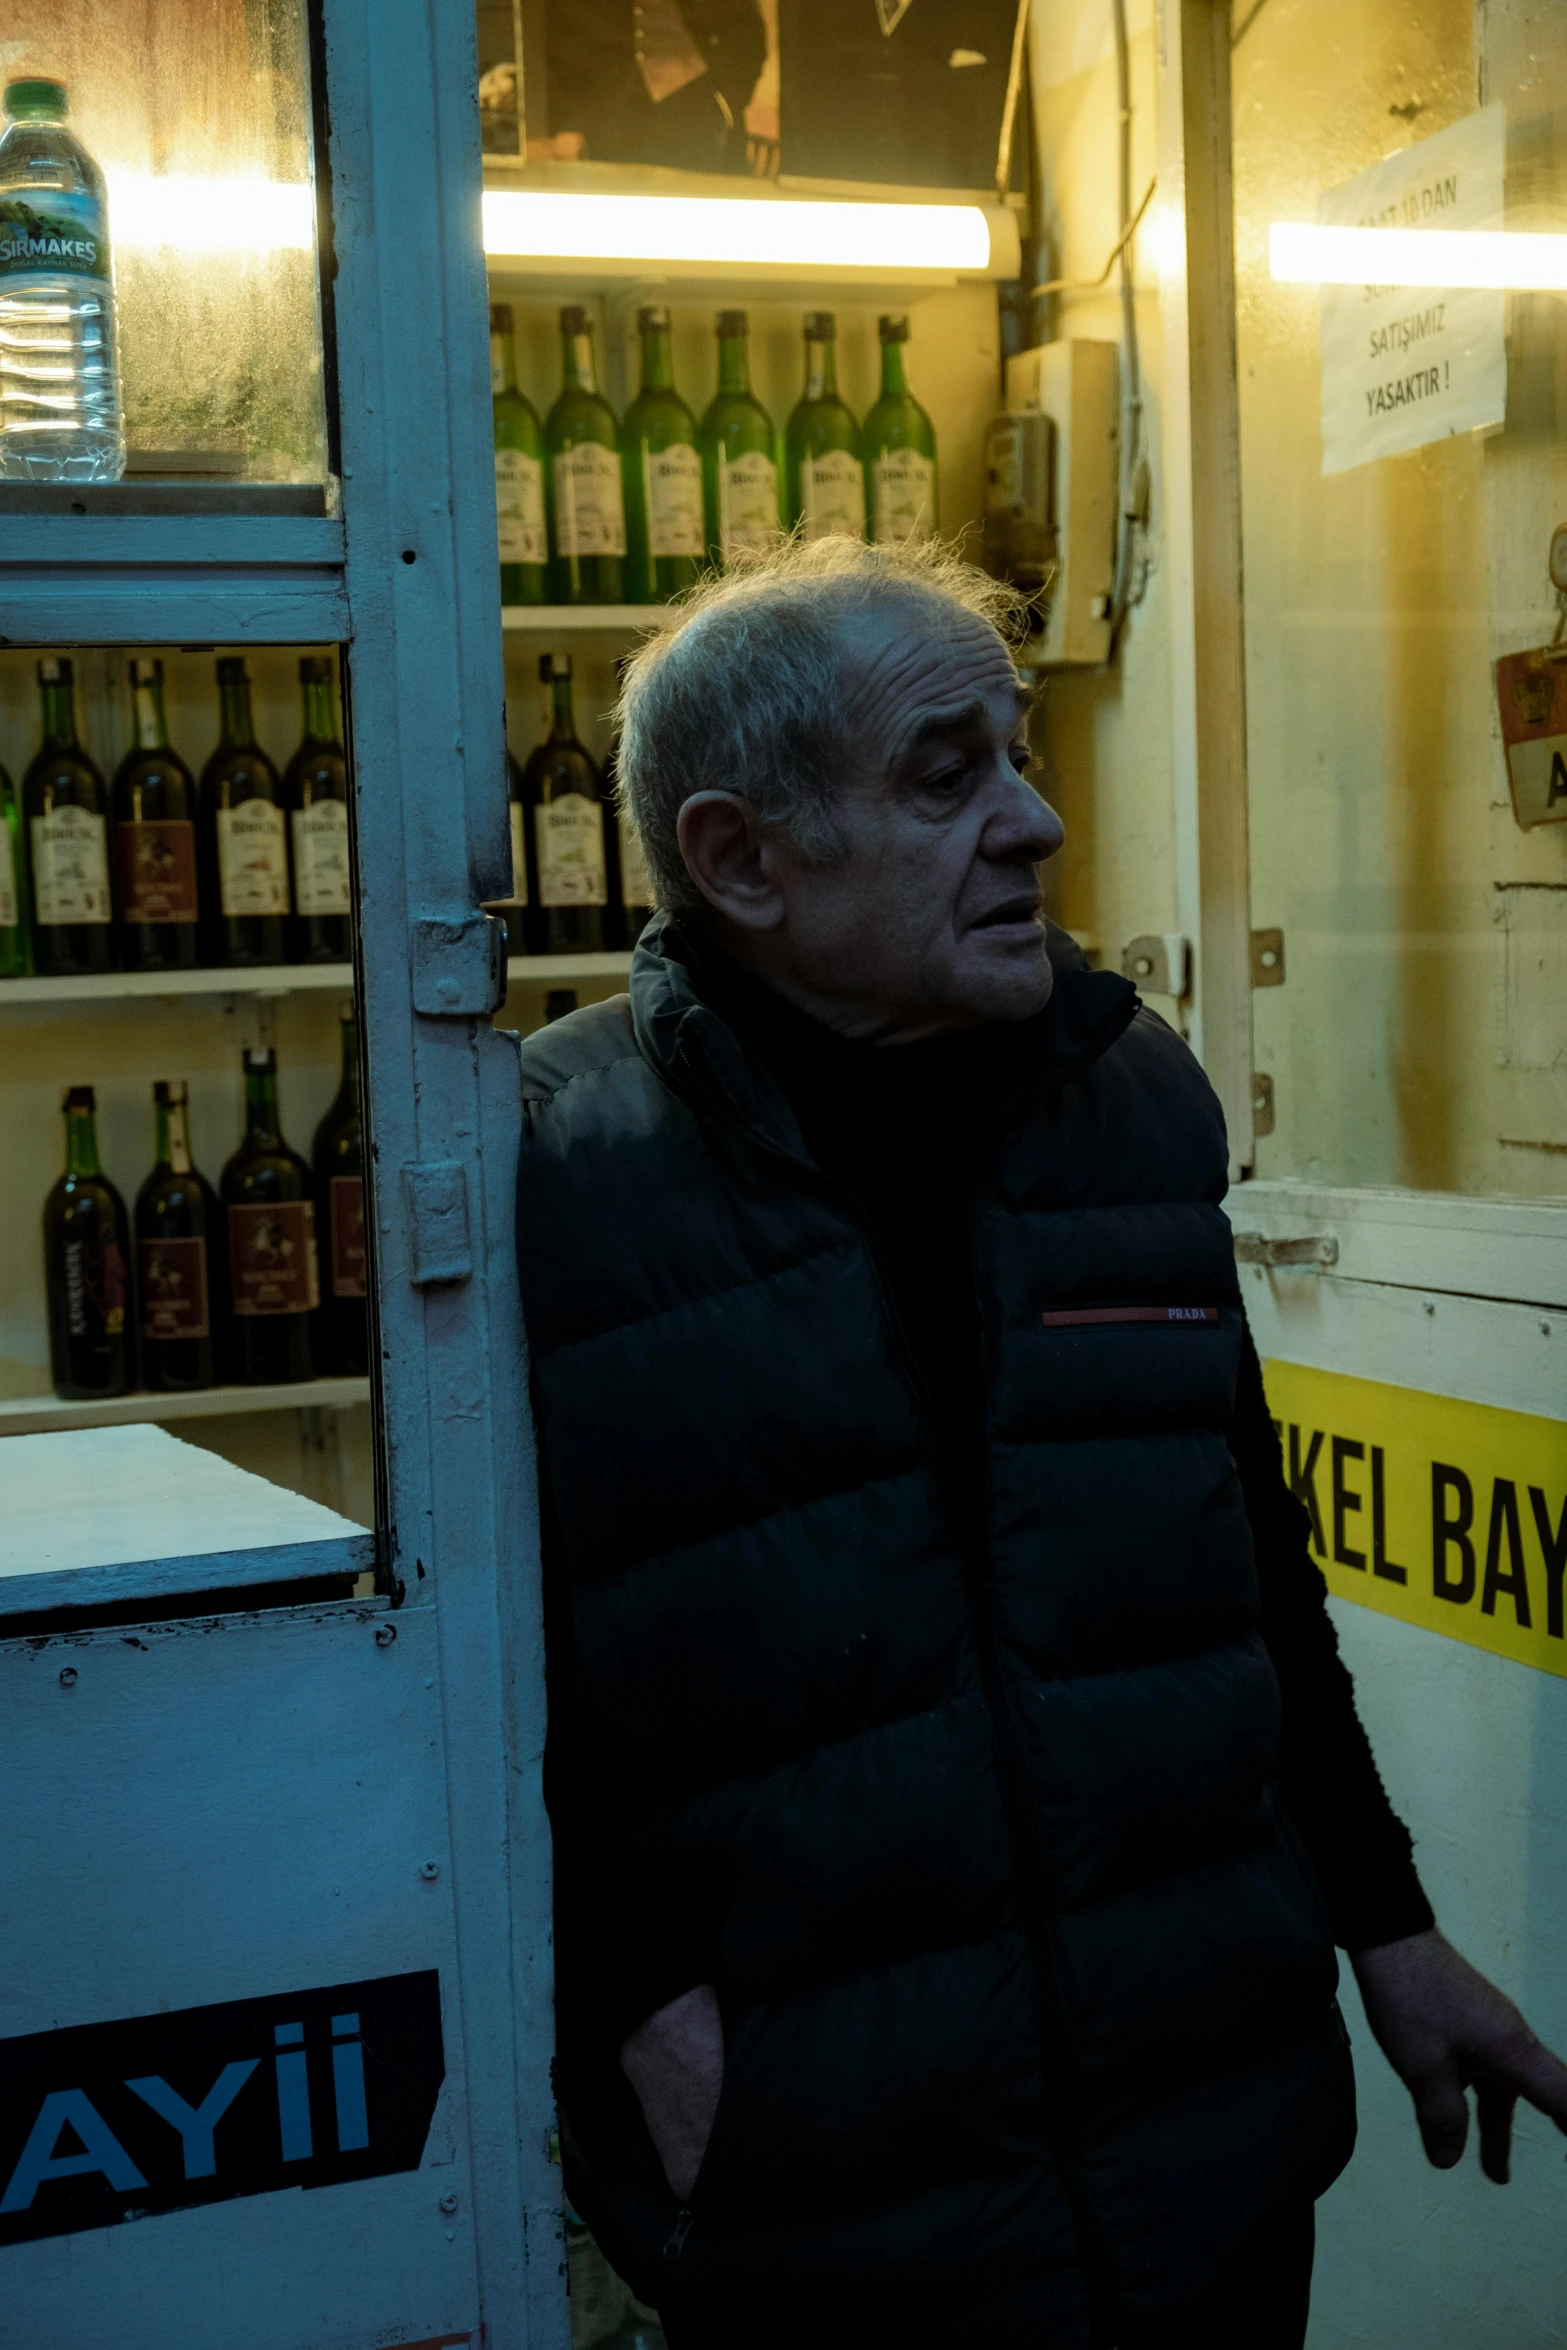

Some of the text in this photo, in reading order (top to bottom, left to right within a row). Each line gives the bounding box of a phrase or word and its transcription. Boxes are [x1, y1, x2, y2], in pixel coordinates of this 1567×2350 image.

[1369, 303, 1446, 358] SATIŞIMIZ
[1365, 366, 1440, 417] YASAKTIR
[1168, 1308, 1206, 1320] PRADA
[1272, 1417, 1408, 1587] KEL
